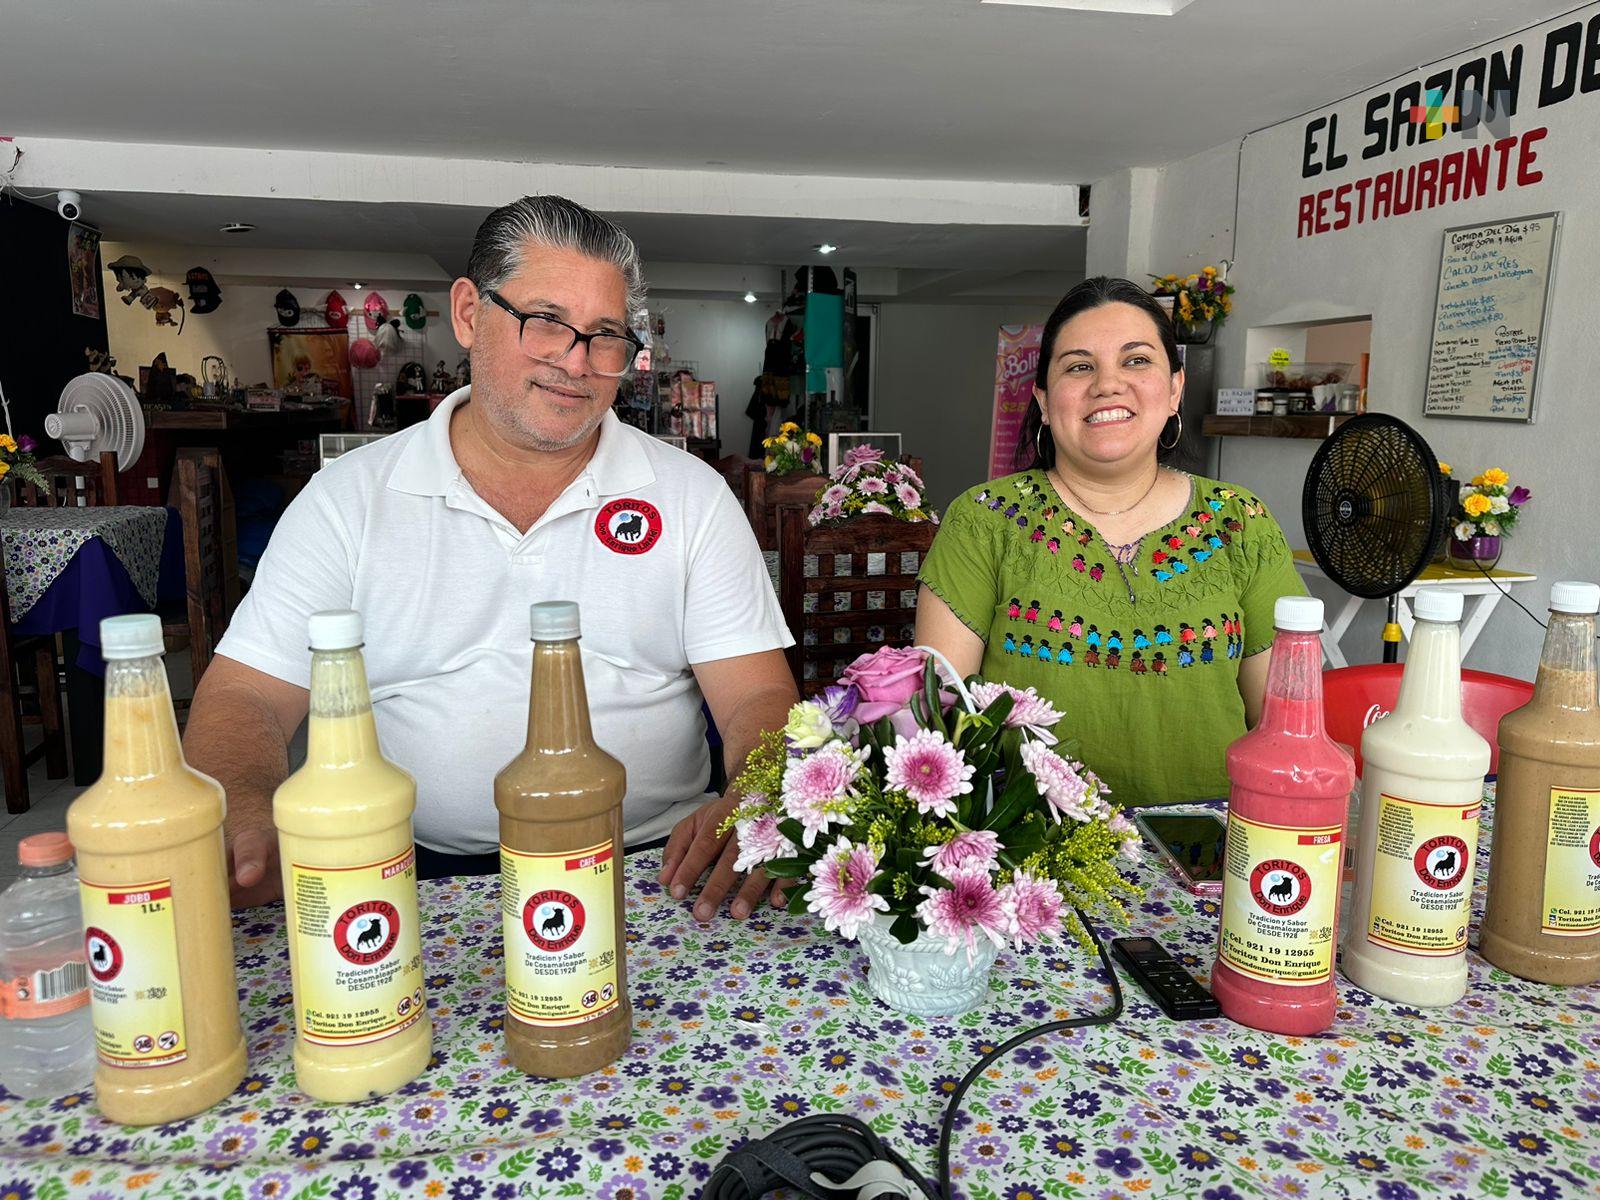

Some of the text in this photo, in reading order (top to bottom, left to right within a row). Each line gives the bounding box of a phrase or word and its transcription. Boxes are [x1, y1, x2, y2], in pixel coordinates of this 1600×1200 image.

[1302, 113, 1348, 179] EL
[1362, 44, 1523, 160] SAZON
[1297, 127, 1548, 239] RESTAURANTE
[1451, 231, 1483, 245] COMIDA
[606, 502, 657, 520] TORITOS
[1313, 835, 1331, 844] FRESA
[1421, 836, 1468, 853] TORITOS
[1255, 860, 1307, 881] TORITOS
[1419, 867, 1465, 888] Don Enrique
[124, 892, 151, 904] JOBO
[526, 891, 579, 910] TORITOS
[1255, 890, 1307, 914] Don Enrique
[1412, 889, 1443, 898] Tradicion
[338, 901, 394, 924] TORITOS
[1420, 903, 1444, 911] DESDE
[1247, 918, 1309, 934] De Cosamaloapan
[1249, 912, 1280, 925] Tradicion
[1381, 918, 1394, 927] Cel.
[528, 924, 582, 950] Don Enrique
[1257, 927, 1298, 939] DESDE 1928
[1381, 925, 1405, 937] Toritos
[341, 932, 397, 962] Don Enrique
[1229, 932, 1315, 957] Cel. 921 19 12955
[525, 952, 557, 961] Tradicion
[563, 951, 585, 960] Sabor
[534, 958, 587, 969] Cosamaloapan
[1229, 943, 1321, 969] Toritos Don Enrique
[337, 966, 373, 977] Tradicion
[380, 959, 401, 970] Sabor
[535, 966, 576, 976] DESDE 1928
[1229, 953, 1328, 977] toritosdonenrique@gmail.com
[347, 965, 402, 984] Cosamaloapan
[348, 975, 393, 992] DESDE 1928
[312, 1010, 324, 1018] Cel.
[355, 1015, 387, 1026] Enrique
